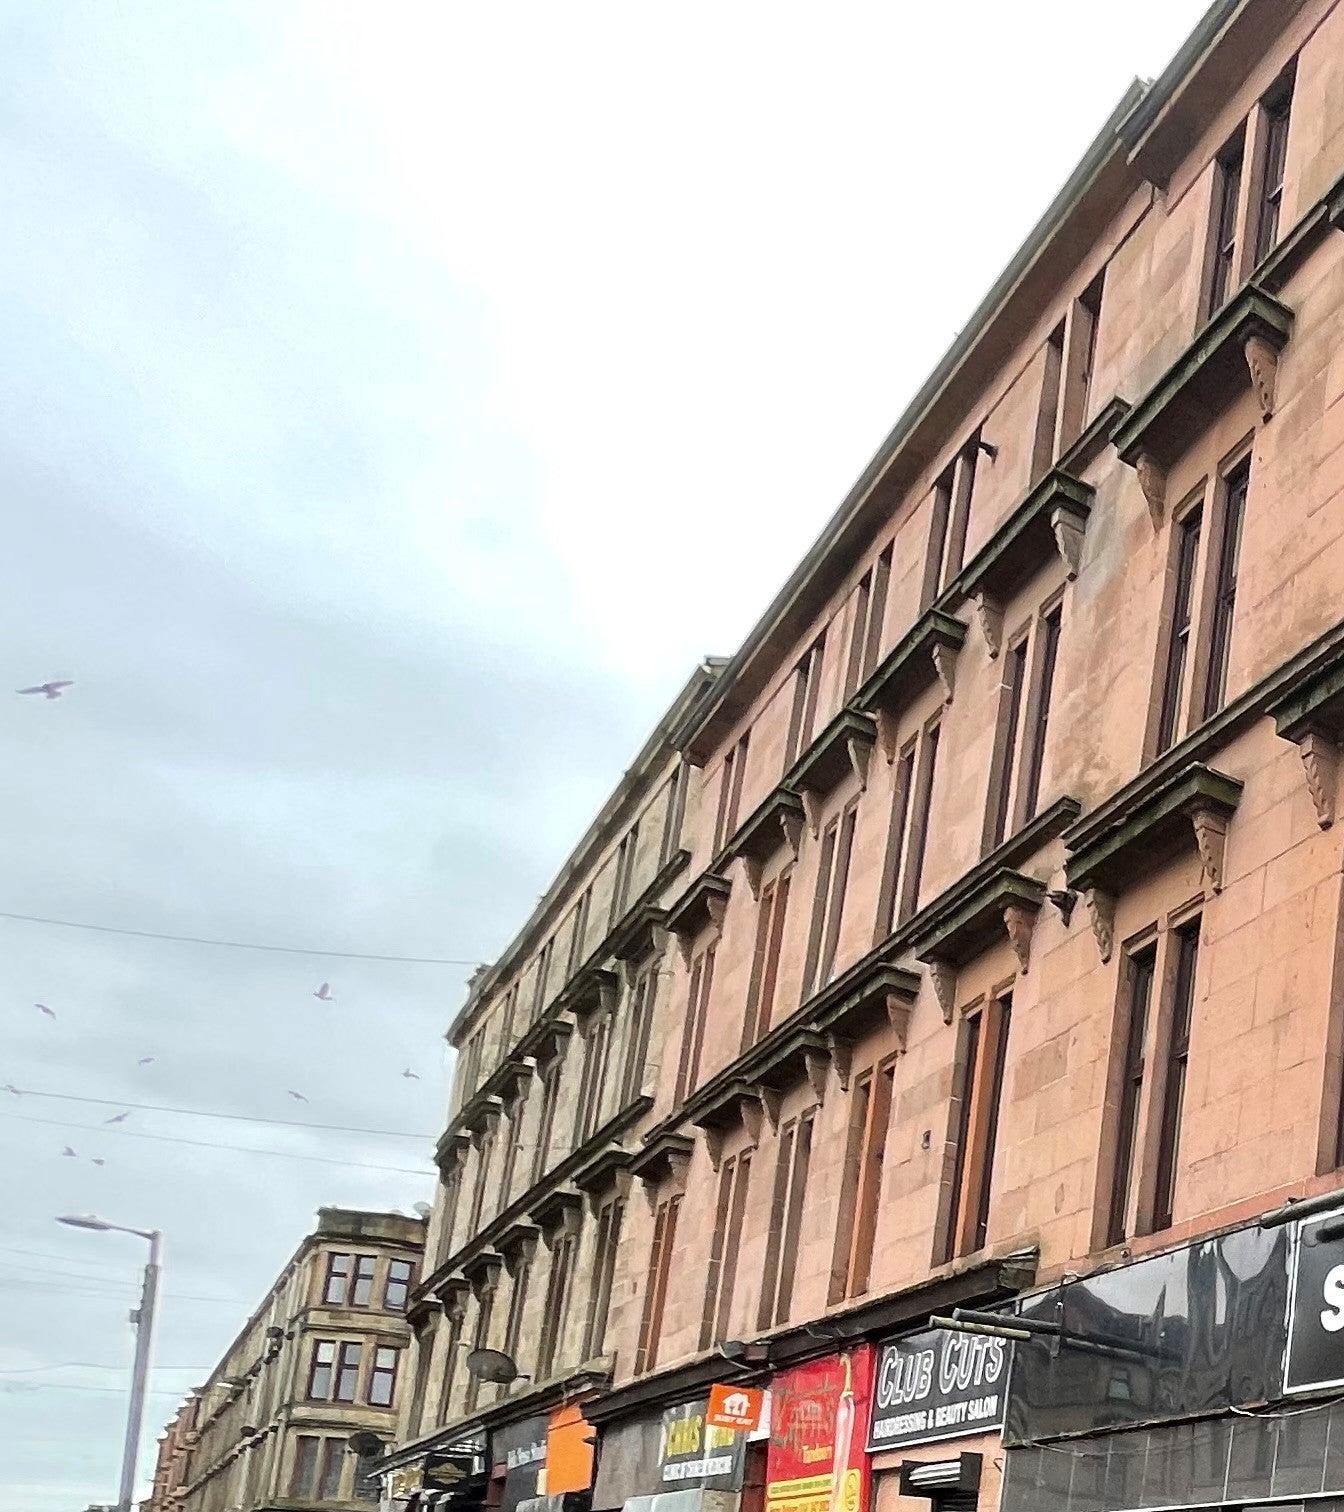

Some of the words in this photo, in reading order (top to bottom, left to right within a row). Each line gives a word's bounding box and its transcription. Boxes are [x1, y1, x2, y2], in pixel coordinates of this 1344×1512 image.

[878, 1346, 934, 1409] CLUB
[940, 1330, 1006, 1394] CUTS
[935, 1401, 968, 1427] BEAUTY
[968, 1395, 998, 1420] SALON
